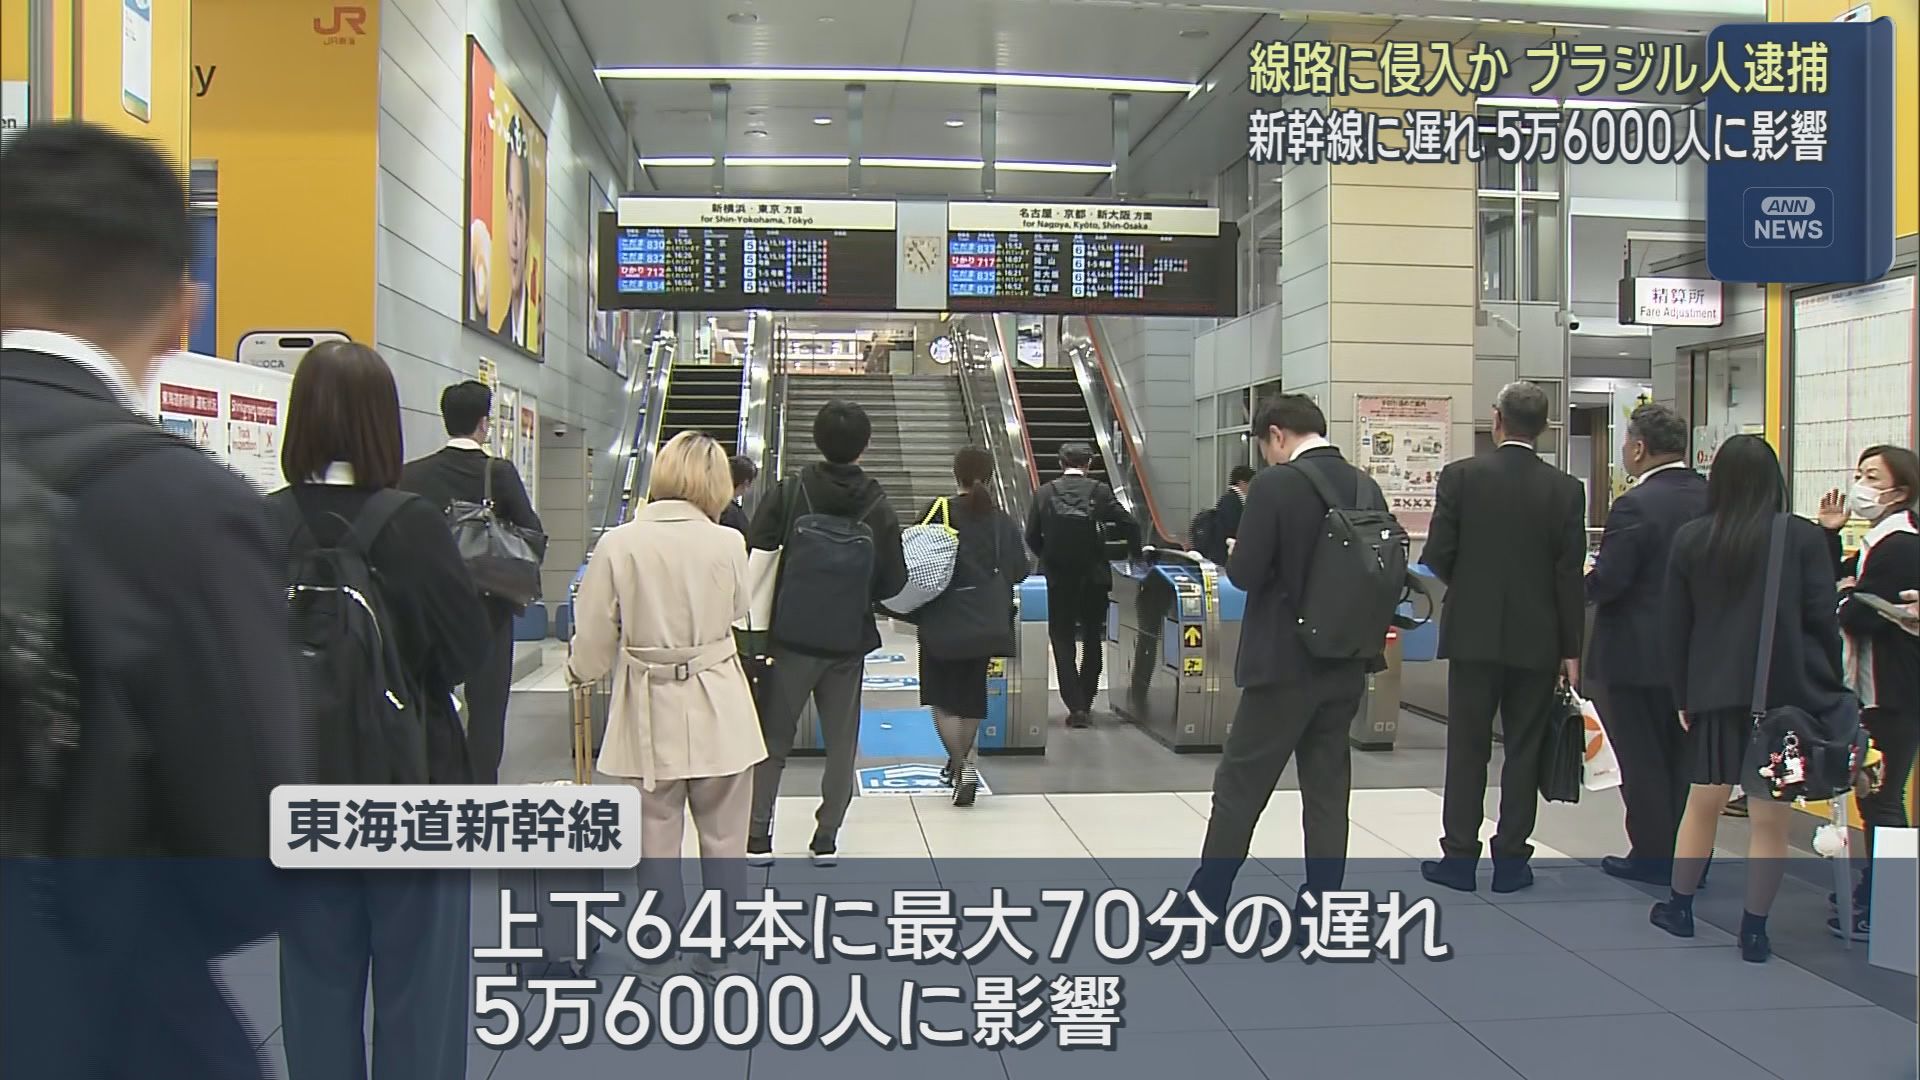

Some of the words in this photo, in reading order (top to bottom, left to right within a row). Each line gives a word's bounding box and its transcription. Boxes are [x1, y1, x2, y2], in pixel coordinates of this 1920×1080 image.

[313, 6, 366, 35] JR
[701, 215, 713, 223] for
[715, 215, 785, 225] Shin-Yokohama,
[1022, 219, 1036, 228] for
[1037, 220, 1071, 230] Nagoya,
[1651, 287, 1705, 305] 精算所
[1639, 305, 1661, 317] Fare
[1663, 307, 1717, 320] Adjustment
